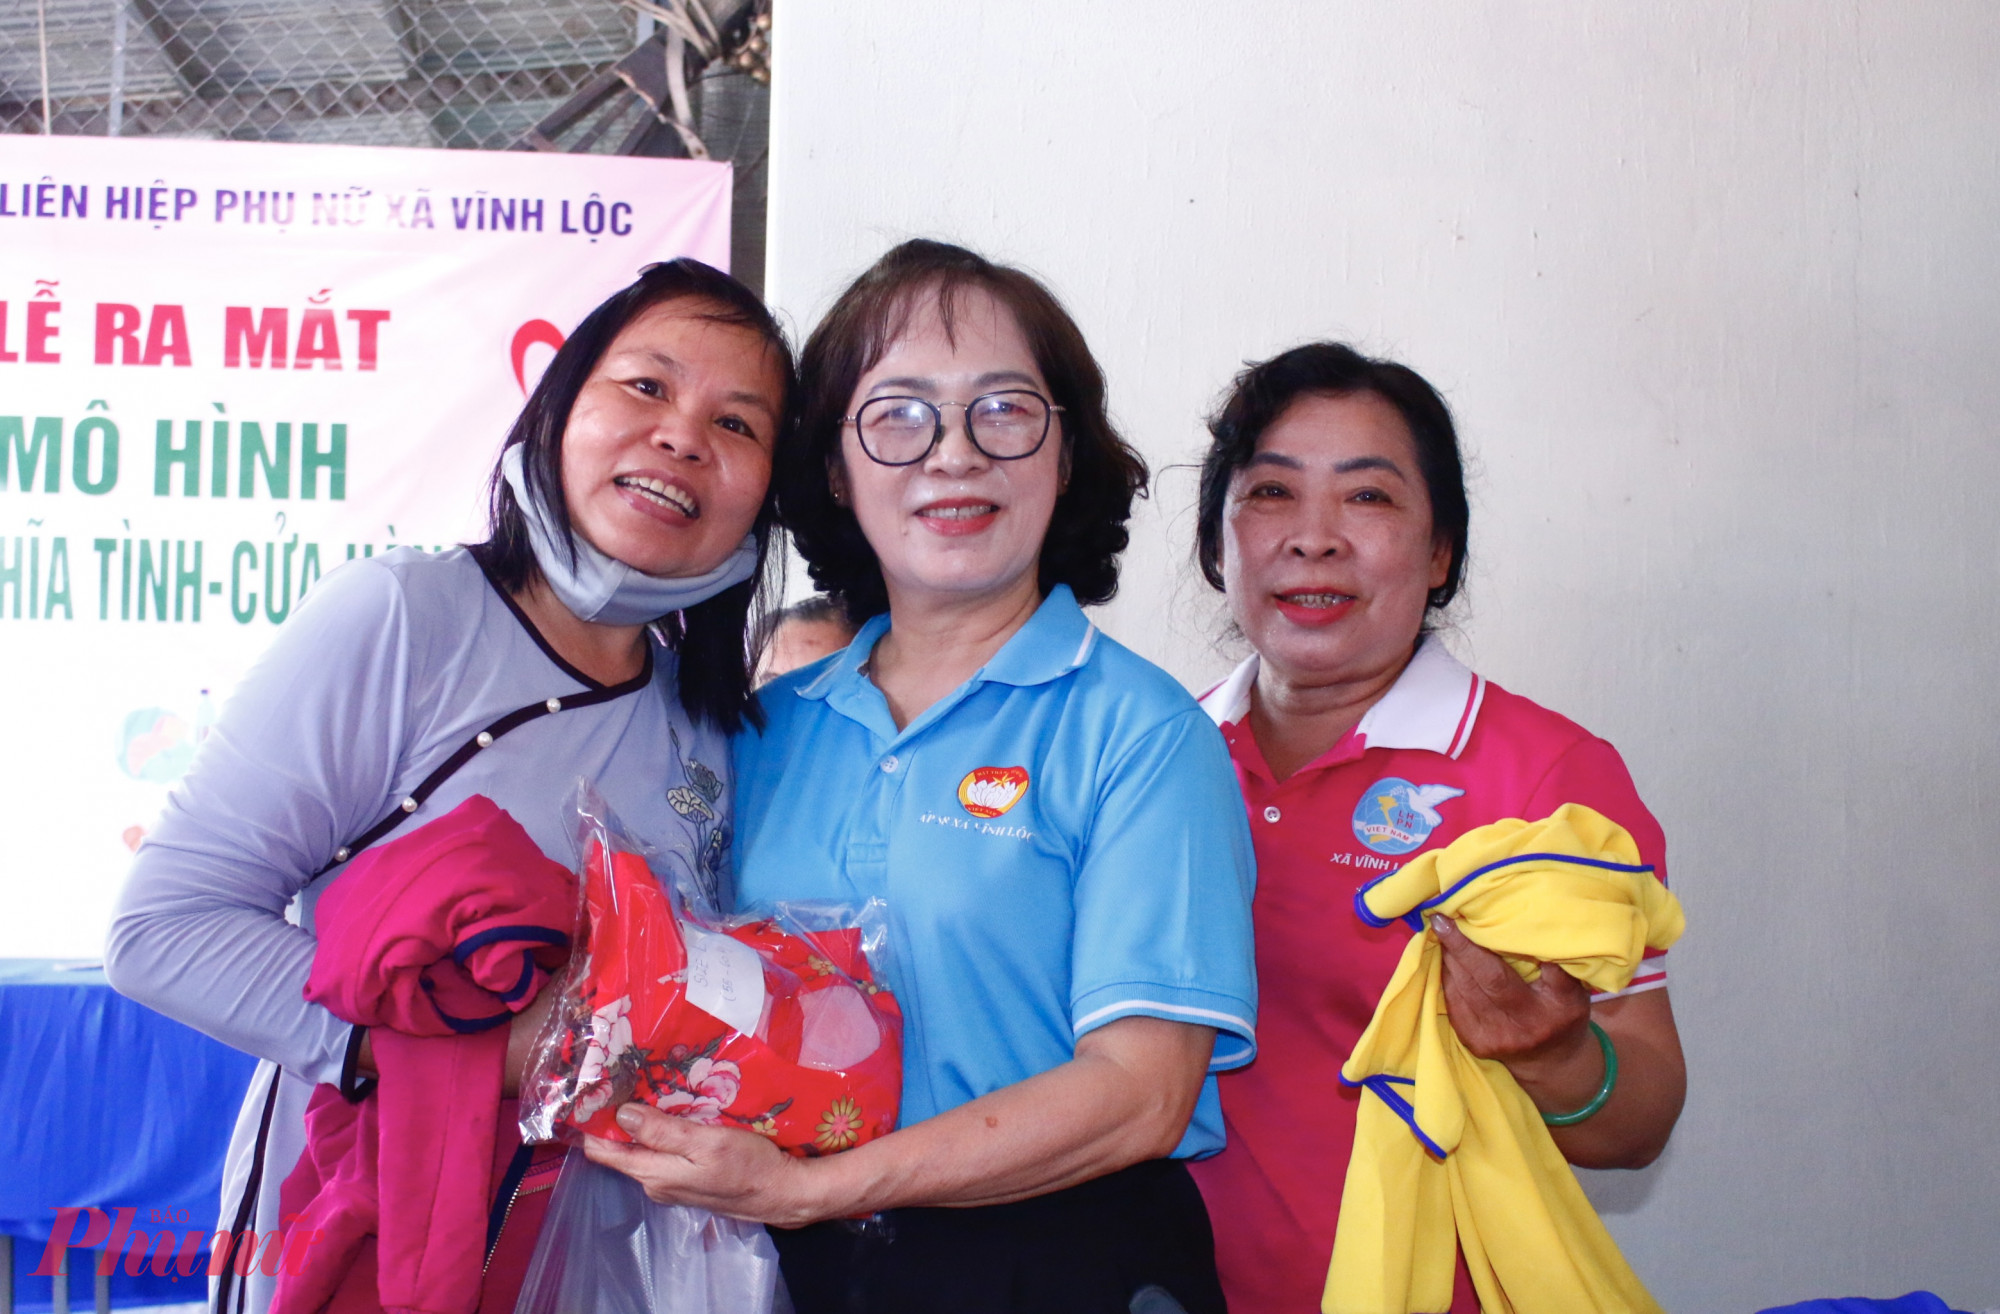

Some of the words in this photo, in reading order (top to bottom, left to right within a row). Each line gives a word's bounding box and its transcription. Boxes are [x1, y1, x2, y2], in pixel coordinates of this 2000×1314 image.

[0, 175, 88, 219] LIÊN
[106, 179, 198, 230] HIỆP
[214, 188, 295, 234] PHỤ
[386, 187, 435, 229] XÃ
[451, 190, 544, 232] VĨNH
[561, 192, 633, 243] LỘC
[94, 302, 193, 366] RA
[224, 288, 391, 371] MẮT
[0, 400, 120, 496] MÔ
[154, 402, 348, 501] HÌNH
[1355, 854, 1391, 870] VĨNH
